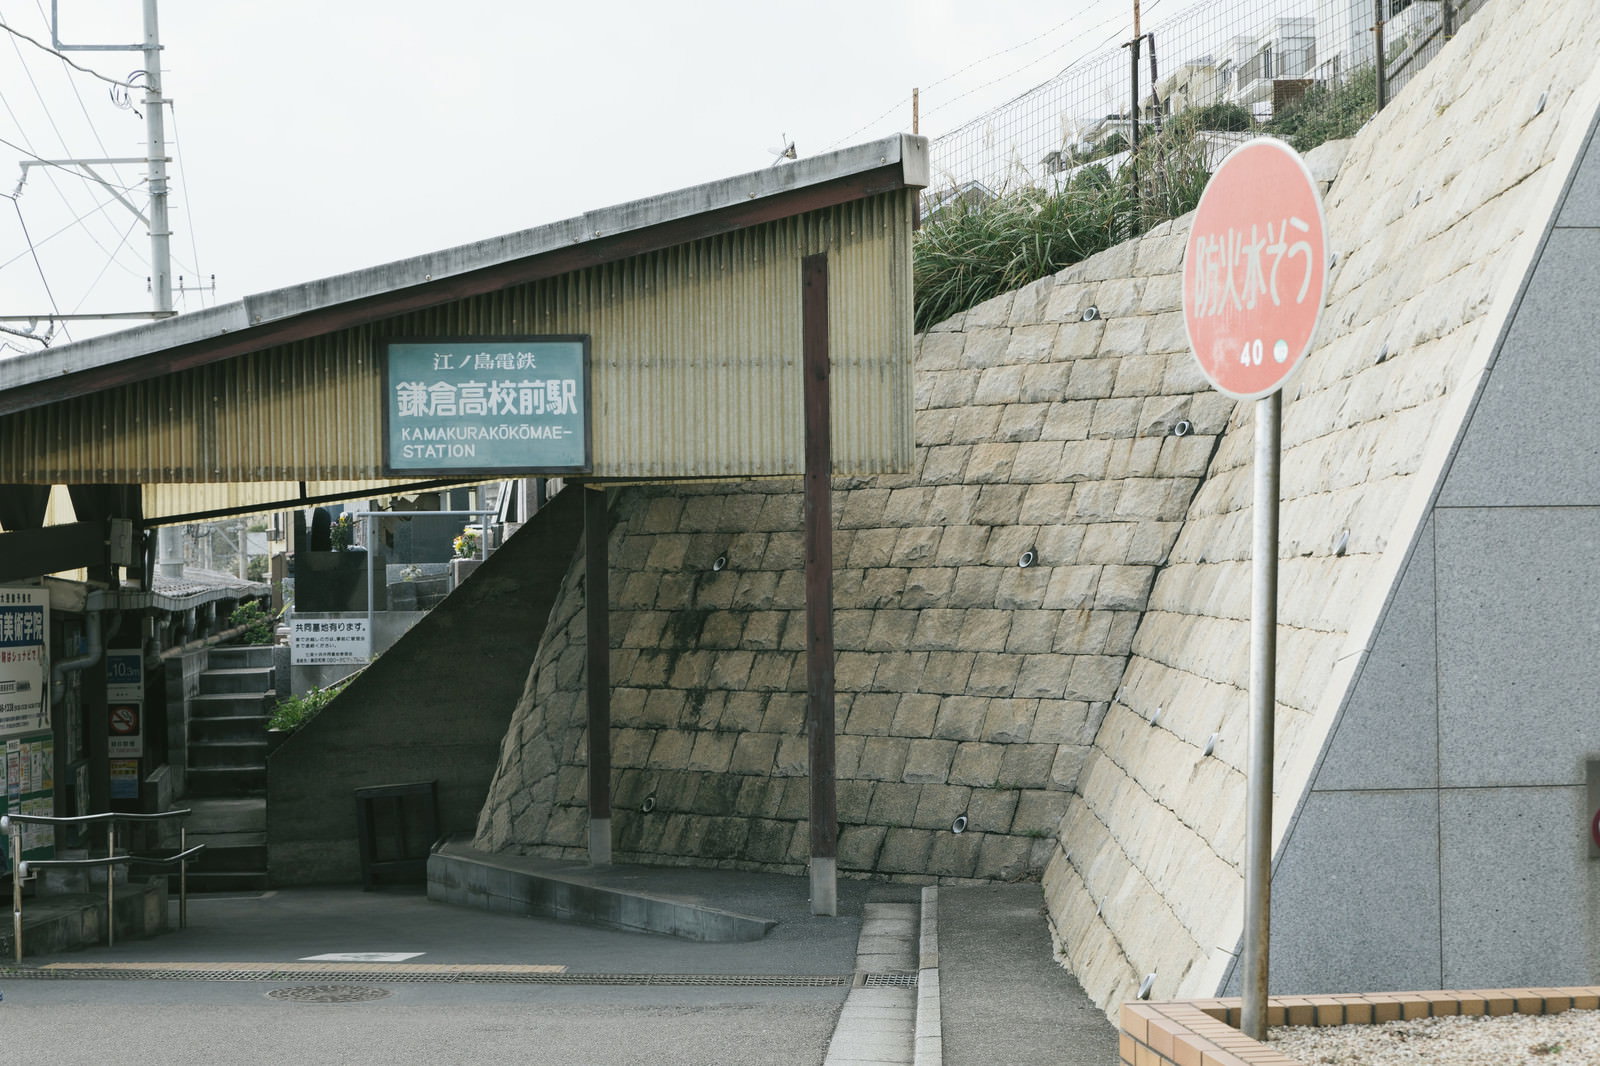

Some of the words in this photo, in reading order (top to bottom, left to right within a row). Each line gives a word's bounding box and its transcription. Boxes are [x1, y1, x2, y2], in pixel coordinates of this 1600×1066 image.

[1194, 215, 1313, 319] 防火水そう
[433, 351, 537, 371] 江ノ島電鉄
[1240, 338, 1264, 368] 40
[395, 379, 578, 417] 鎌倉高校前駅
[403, 444, 476, 459] STATION
